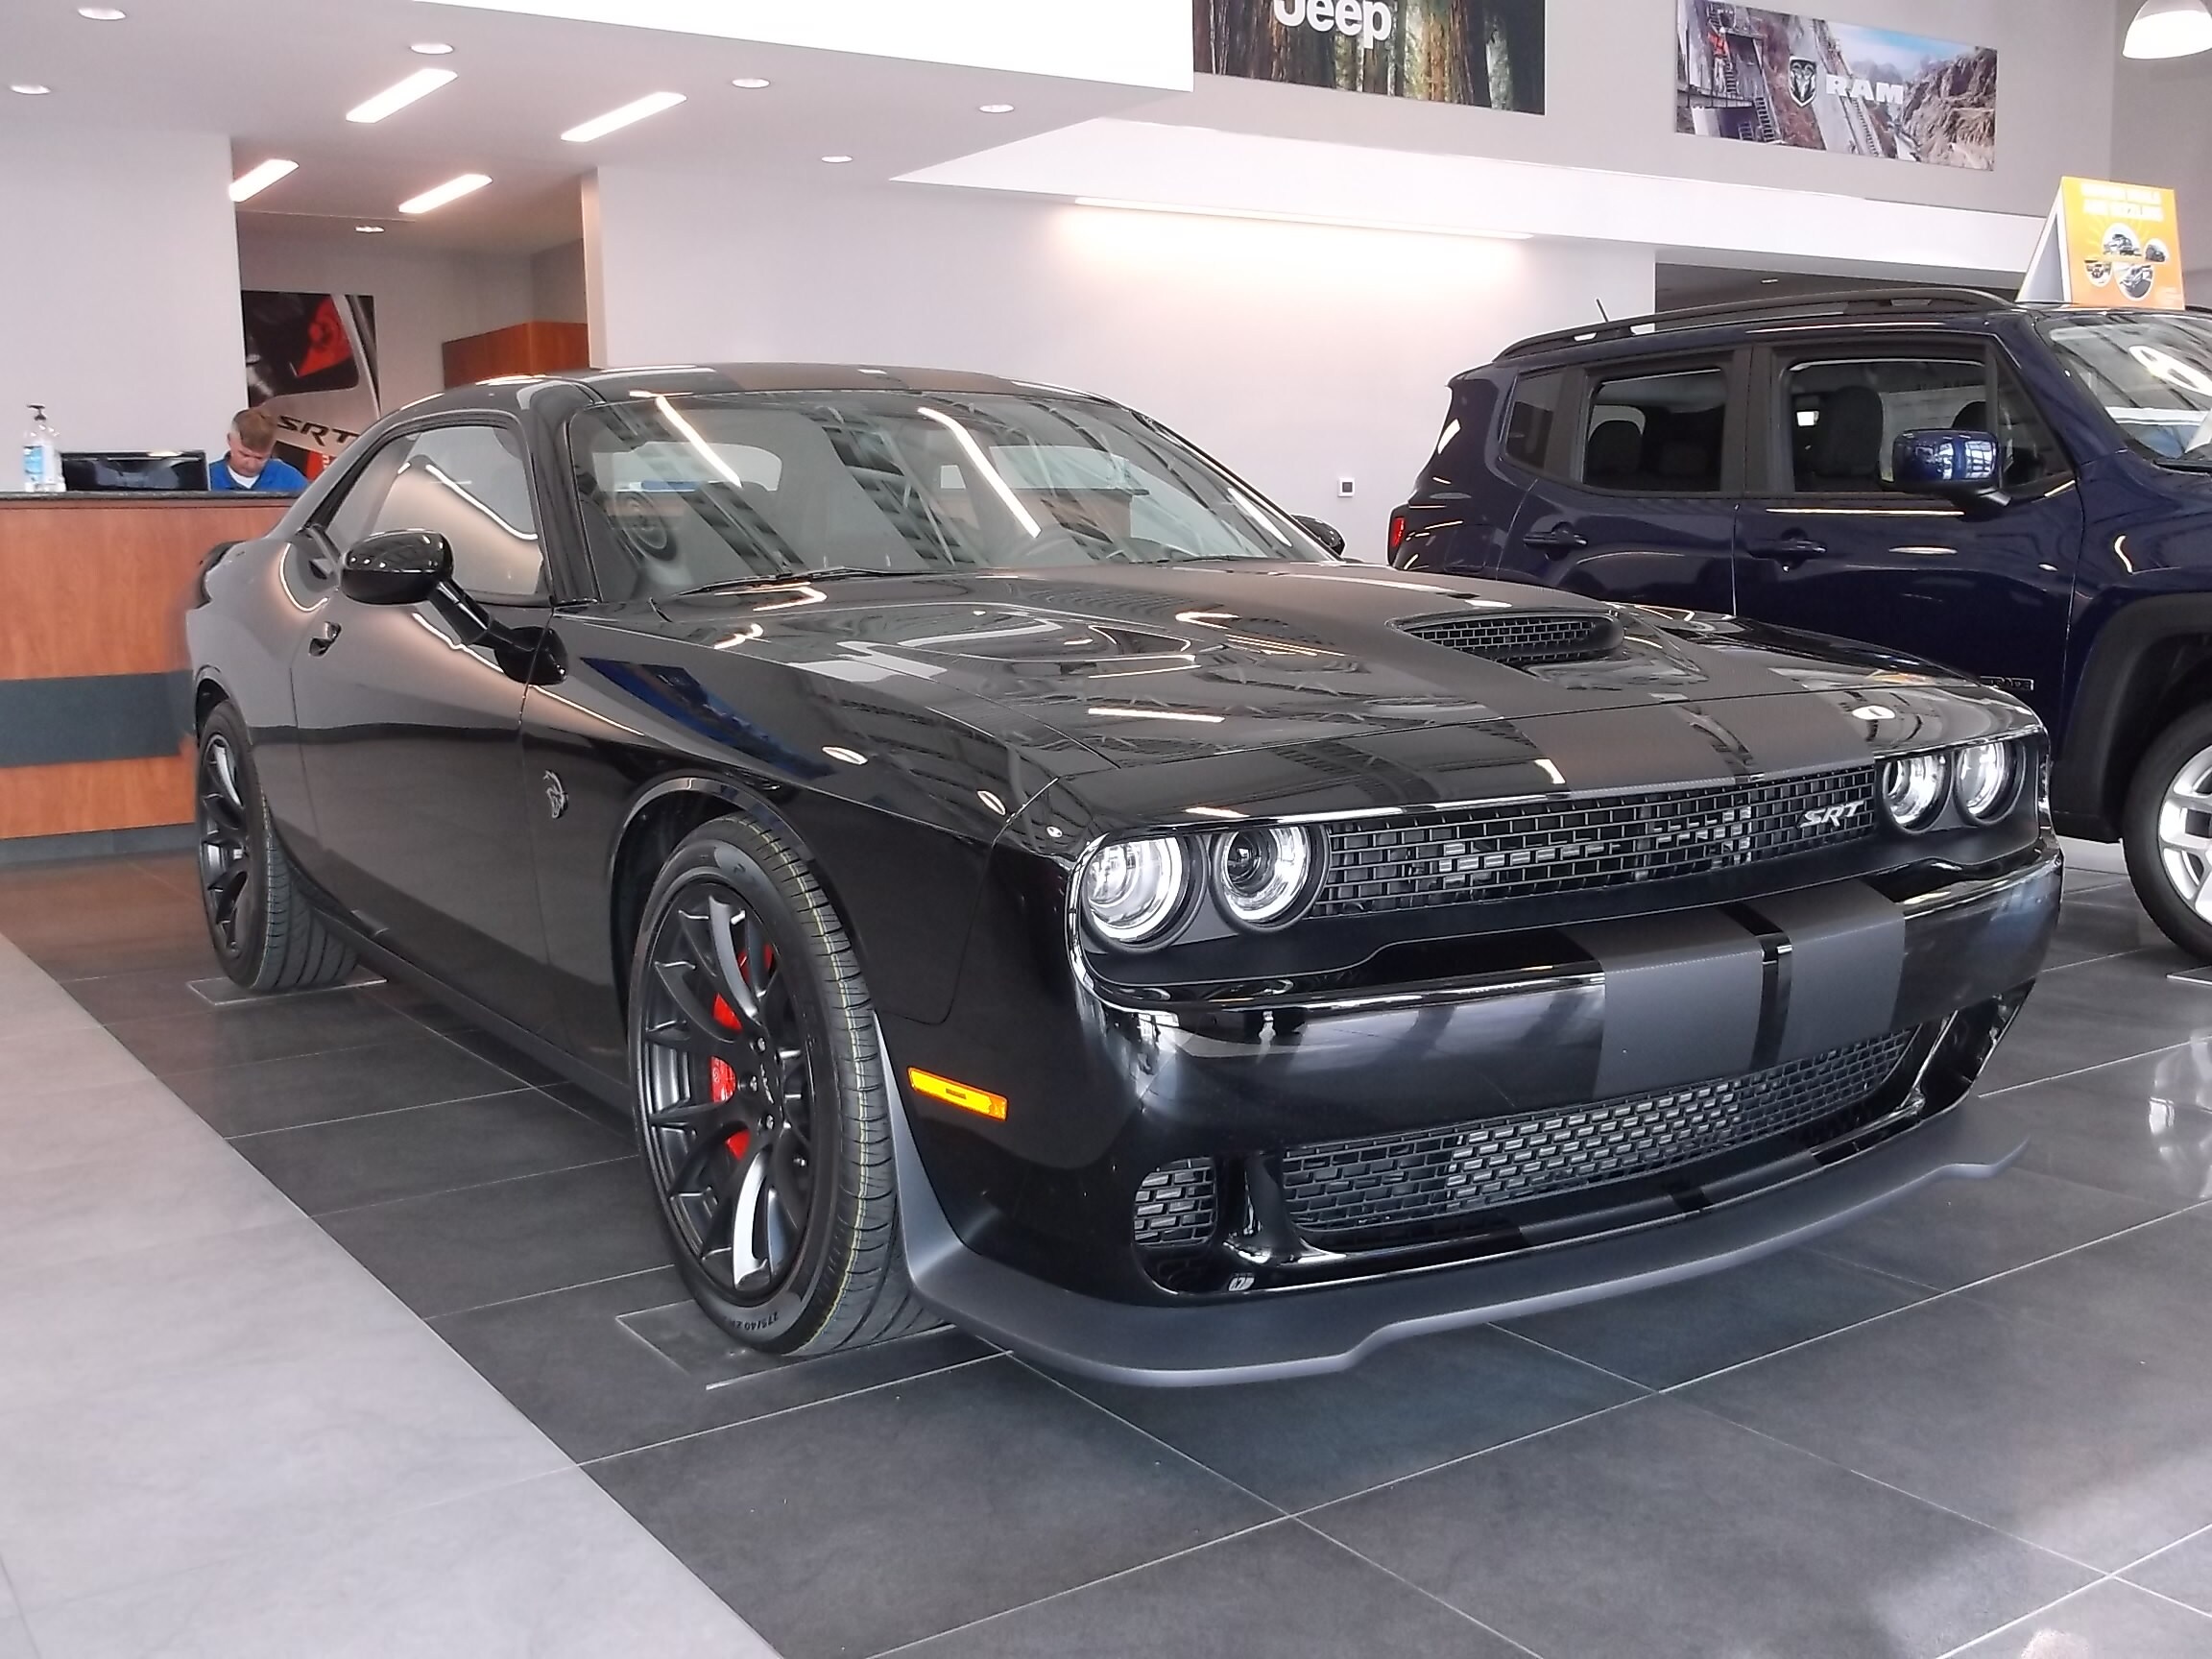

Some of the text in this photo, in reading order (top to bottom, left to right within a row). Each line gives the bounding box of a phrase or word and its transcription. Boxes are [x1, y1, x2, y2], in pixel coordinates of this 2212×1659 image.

[1274, 0, 1392, 49] Jeep
[1826, 74, 1904, 105] RAM
[276, 415, 361, 446] SRT
[1799, 800, 1864, 828] SRT
